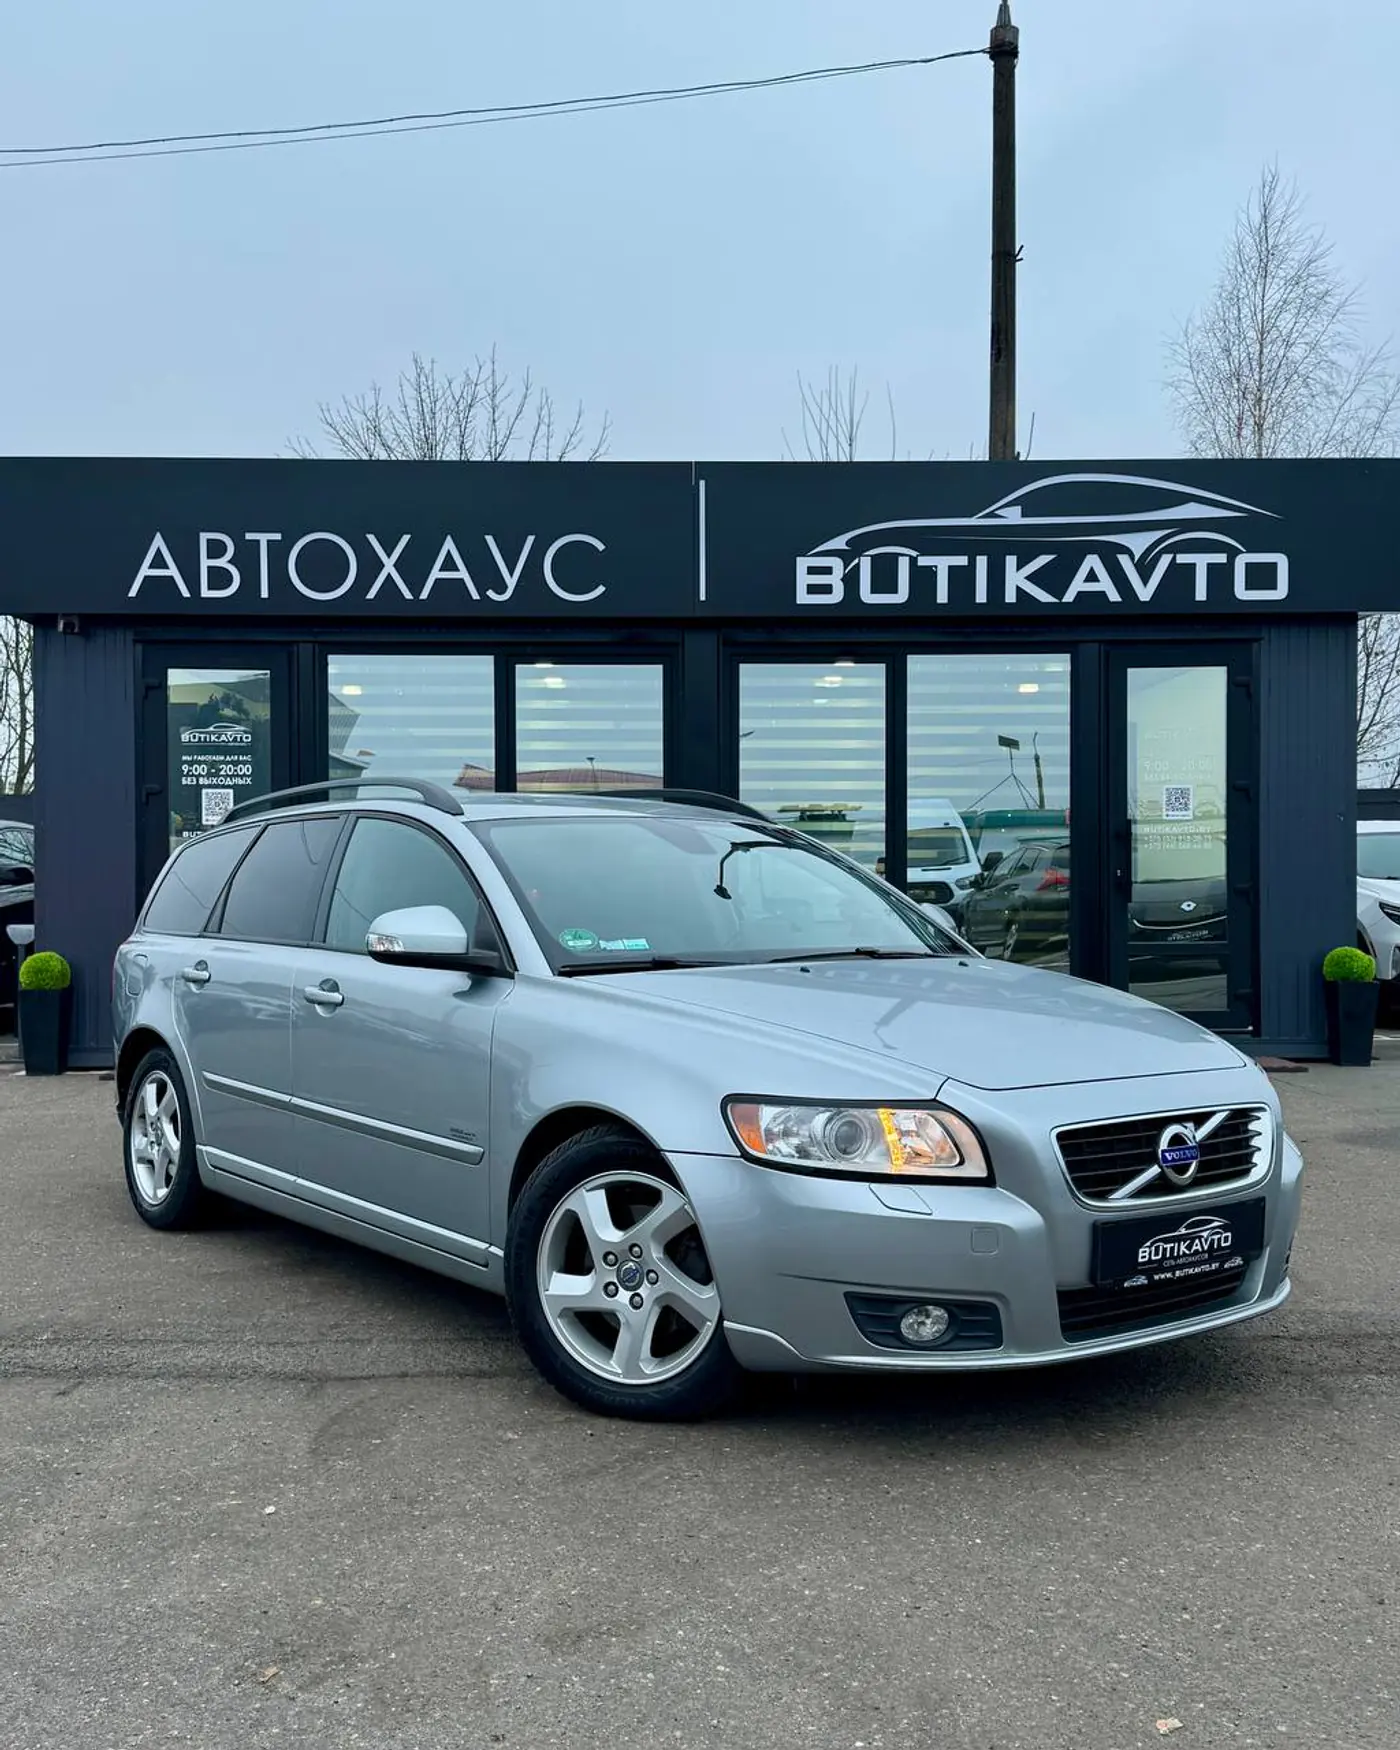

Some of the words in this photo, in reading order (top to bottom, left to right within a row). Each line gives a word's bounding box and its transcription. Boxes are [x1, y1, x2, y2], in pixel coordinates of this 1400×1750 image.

[127, 531, 608, 602] АВТОХАУС
[795, 552, 1289, 605] BUTIKAVTO
[181, 734, 252, 742] BUTIKAVTO
[181, 764, 208, 776] 9:00
[219, 764, 253, 776] 20:00
[181, 776, 197, 785] БЕЗ
[198, 776, 253, 786] ВЫХОДНЫХ
[1163, 1149, 1198, 1161] VOLVO
[1137, 1231, 1232, 1263] BUTIKAVTO
